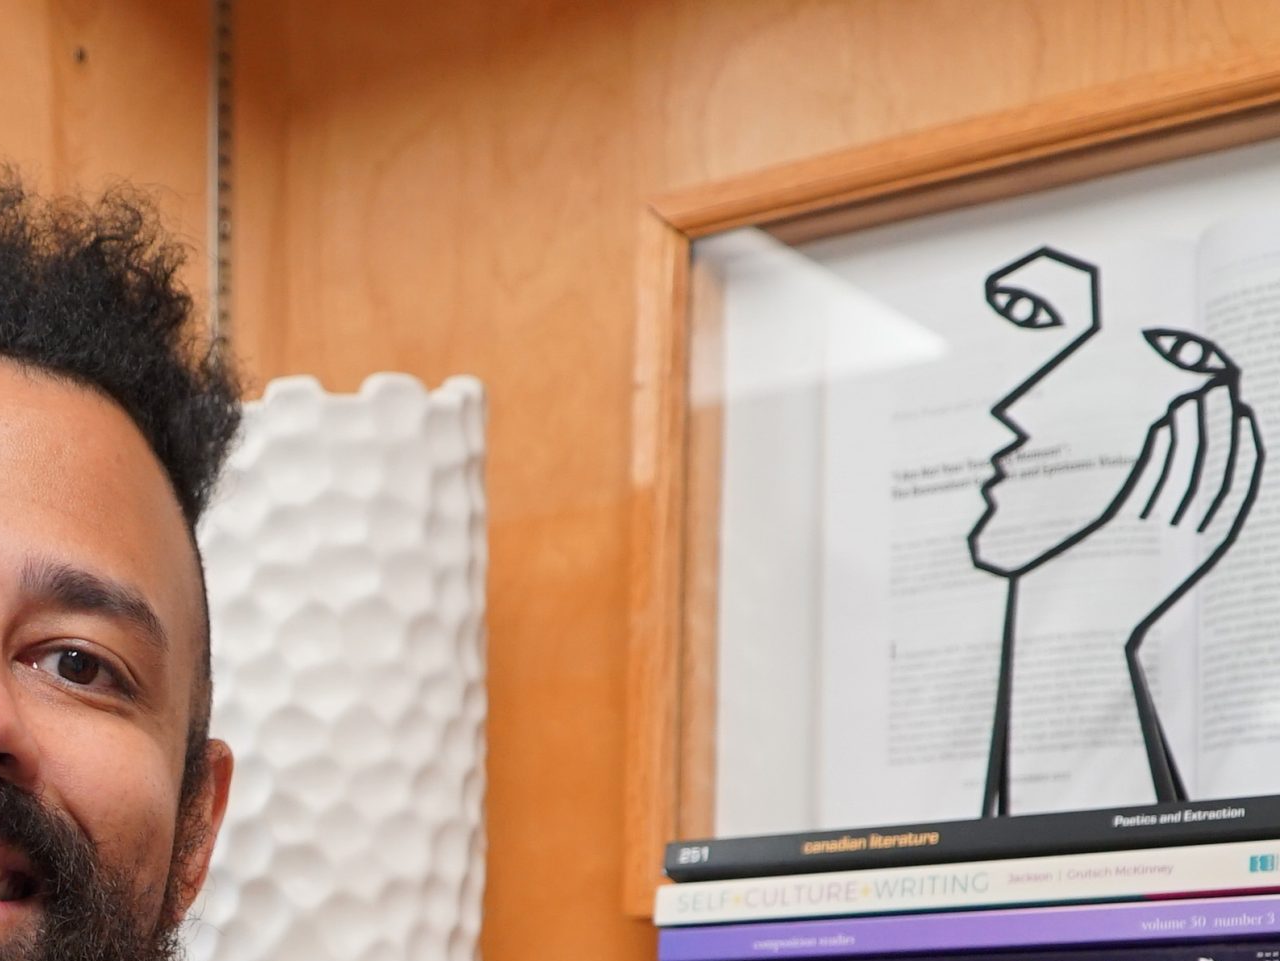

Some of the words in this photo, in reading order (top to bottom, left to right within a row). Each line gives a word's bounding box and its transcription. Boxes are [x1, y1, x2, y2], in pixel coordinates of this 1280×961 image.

[1113, 813, 1157, 827] Poetics
[1160, 810, 1181, 824] and
[1184, 806, 1245, 822] Extraction
[802, 835, 866, 854] canadian
[869, 831, 939, 849] literature
[679, 846, 709, 864] 251
[1007, 871, 1053, 885] Jackson
[1066, 866, 1112, 881] Grutsch
[1115, 863, 1174, 879] McKinney
[1141, 917, 1187, 931] volume
[1213, 913, 1263, 928] number
[1267, 912, 1275, 926] 3
